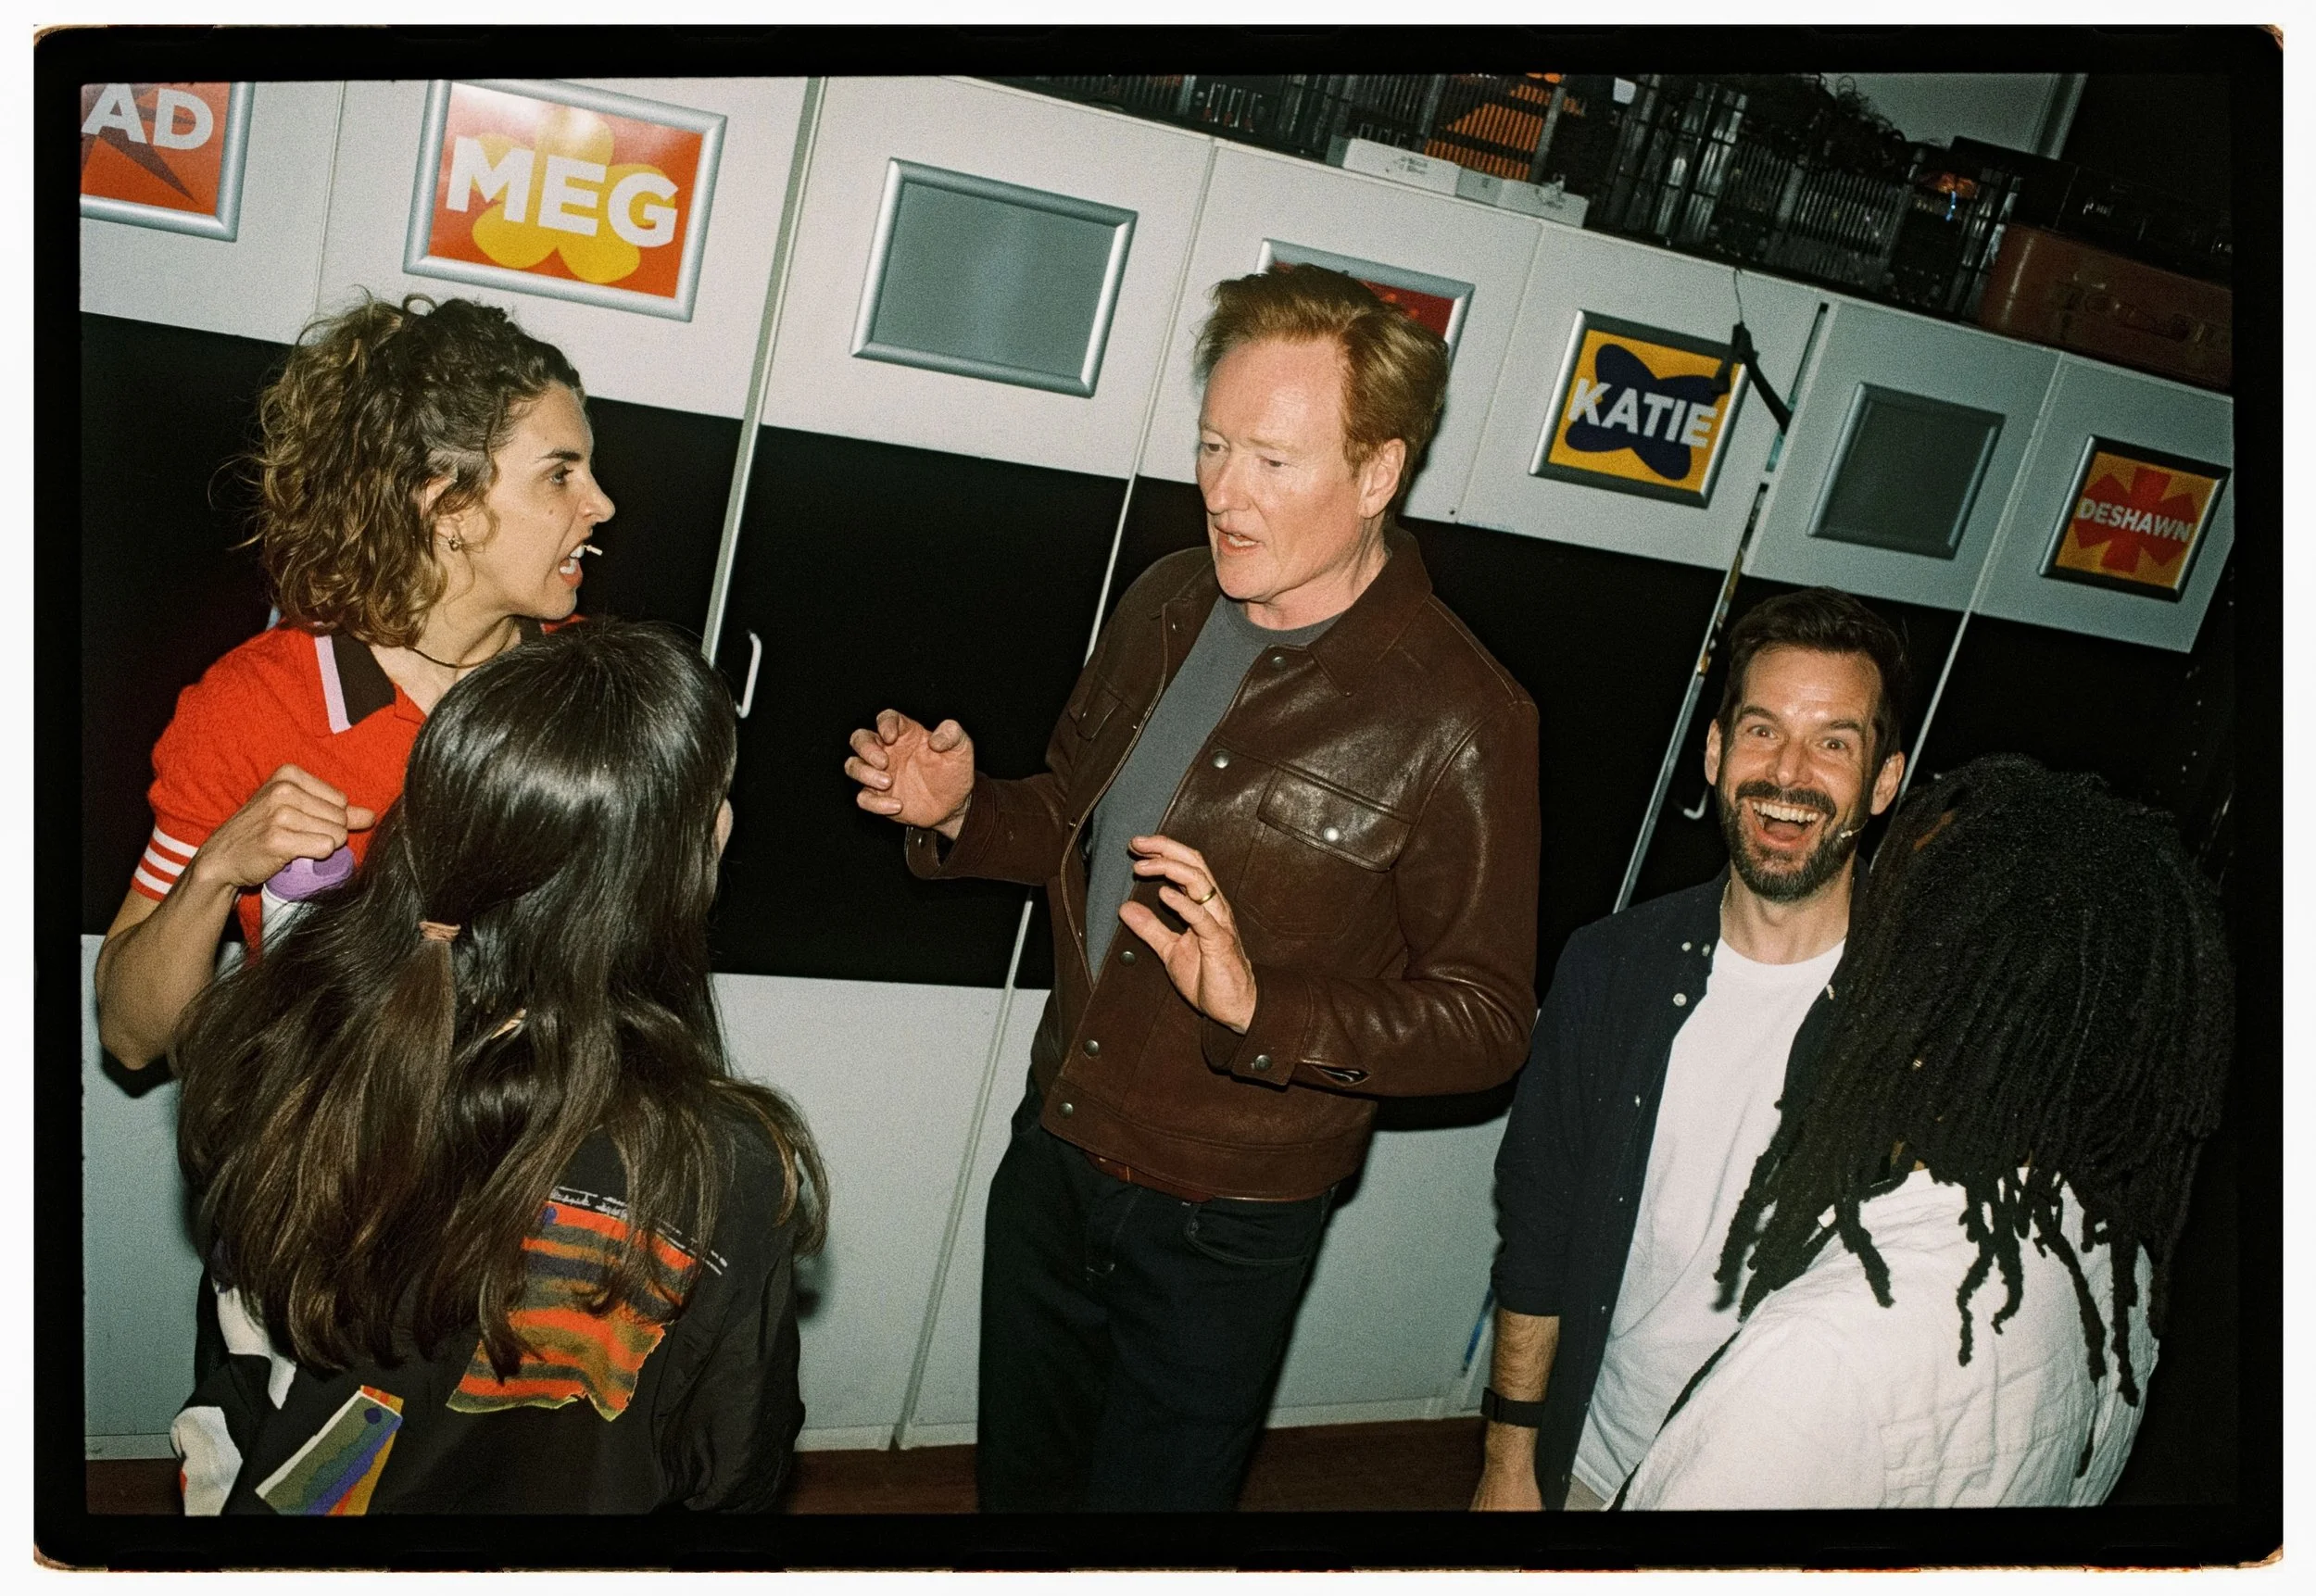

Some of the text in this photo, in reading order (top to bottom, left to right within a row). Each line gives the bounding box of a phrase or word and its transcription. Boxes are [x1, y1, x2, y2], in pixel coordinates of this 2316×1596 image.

[81, 83, 214, 150] AD
[446, 135, 679, 247] MEG
[1567, 378, 1719, 449] KATIE
[2077, 497, 2194, 543] DESHAWN
